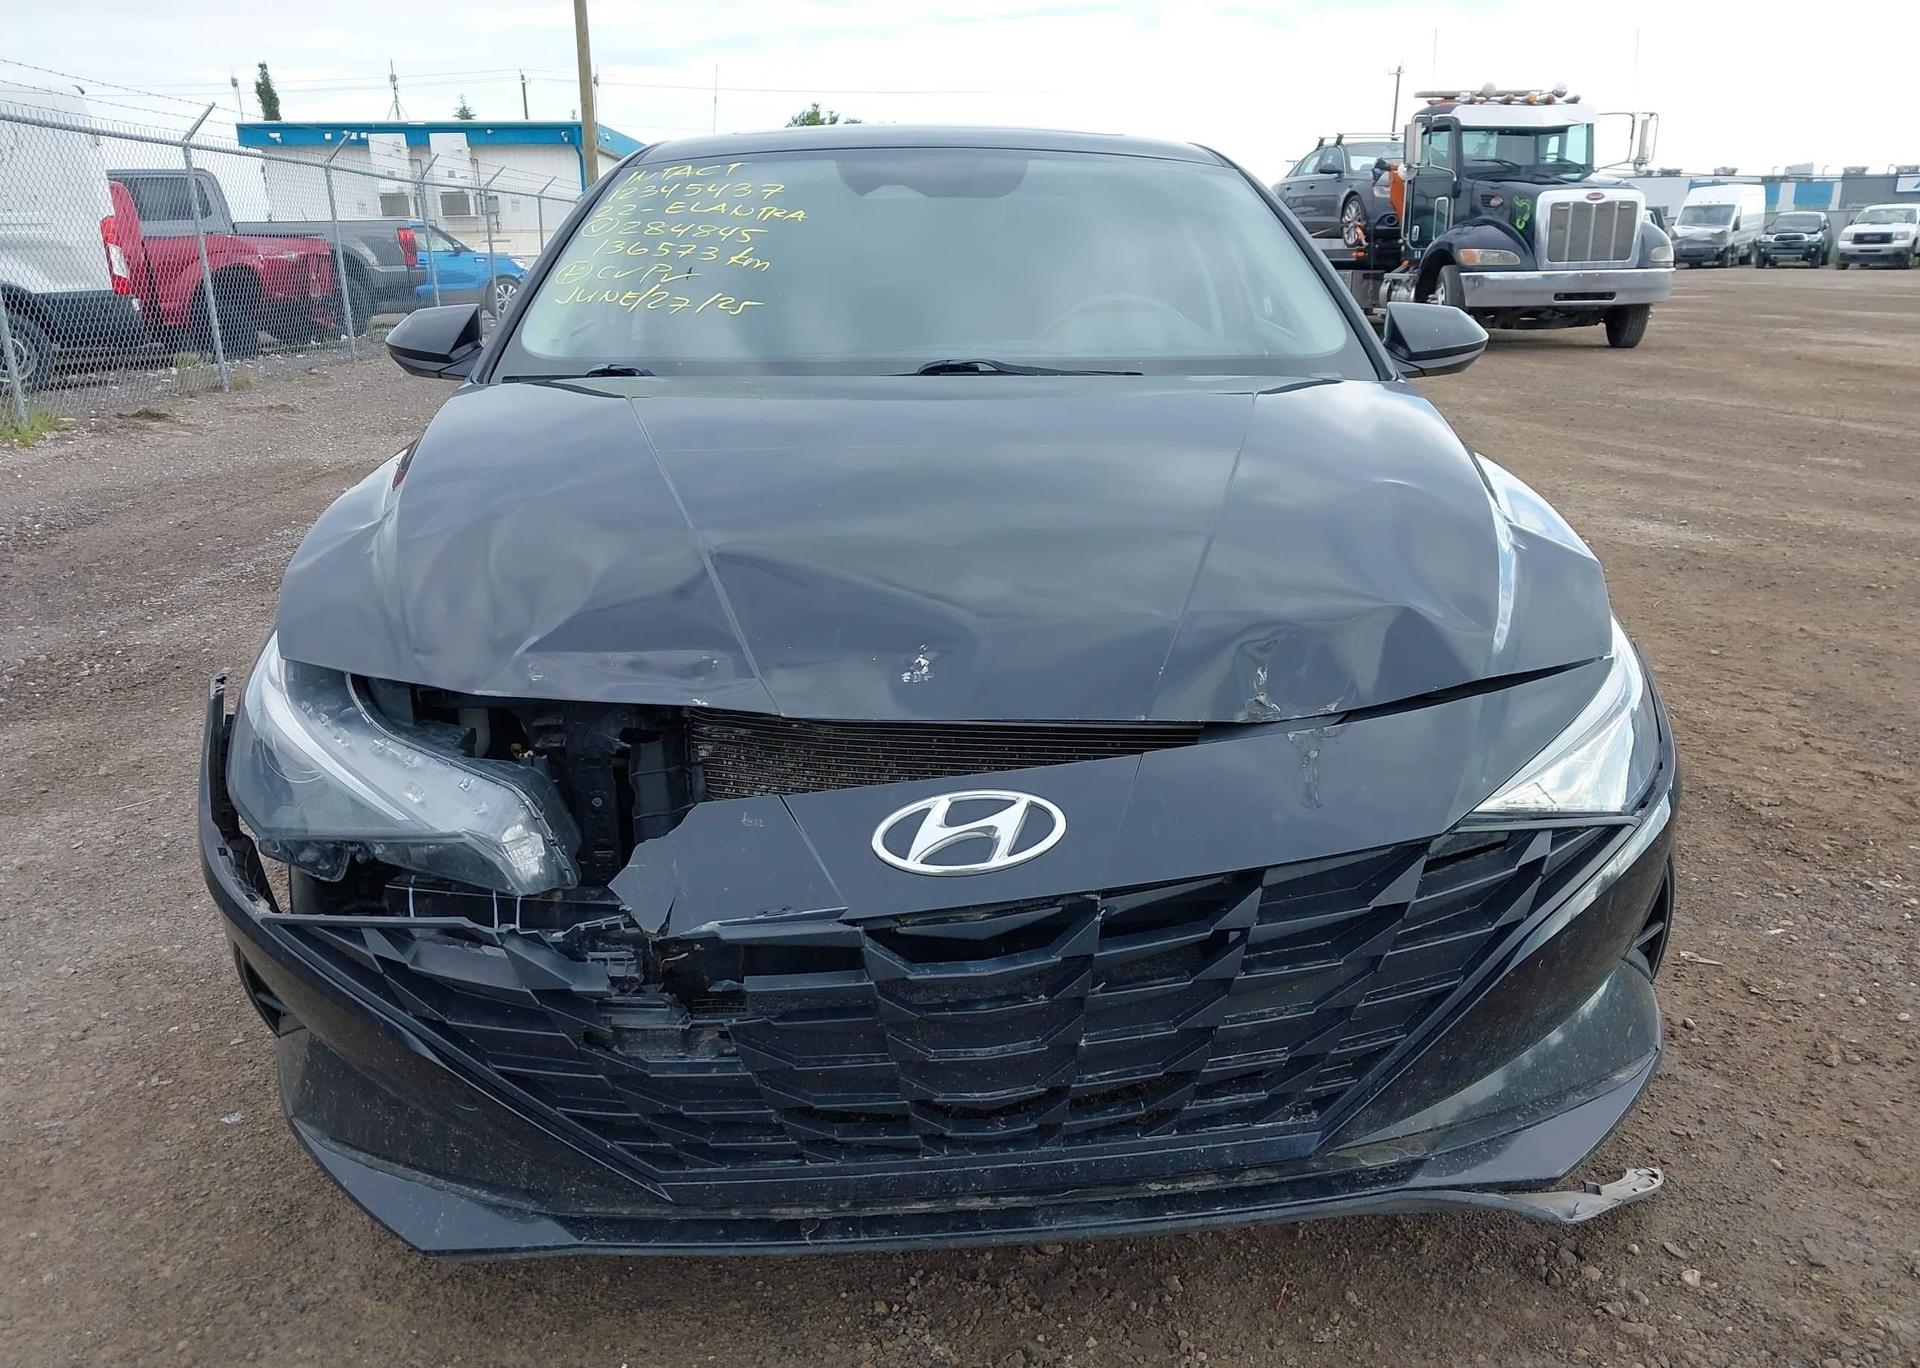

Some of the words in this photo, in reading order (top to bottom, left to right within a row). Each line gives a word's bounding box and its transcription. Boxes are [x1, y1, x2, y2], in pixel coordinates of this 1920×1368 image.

[622, 162, 752, 187] INTACT
[607, 182, 785, 203] 12345437
[664, 201, 809, 223] ELANTRA
[617, 221, 768, 243] 284845
[592, 239, 720, 261] 136573
[727, 246, 772, 272] km
